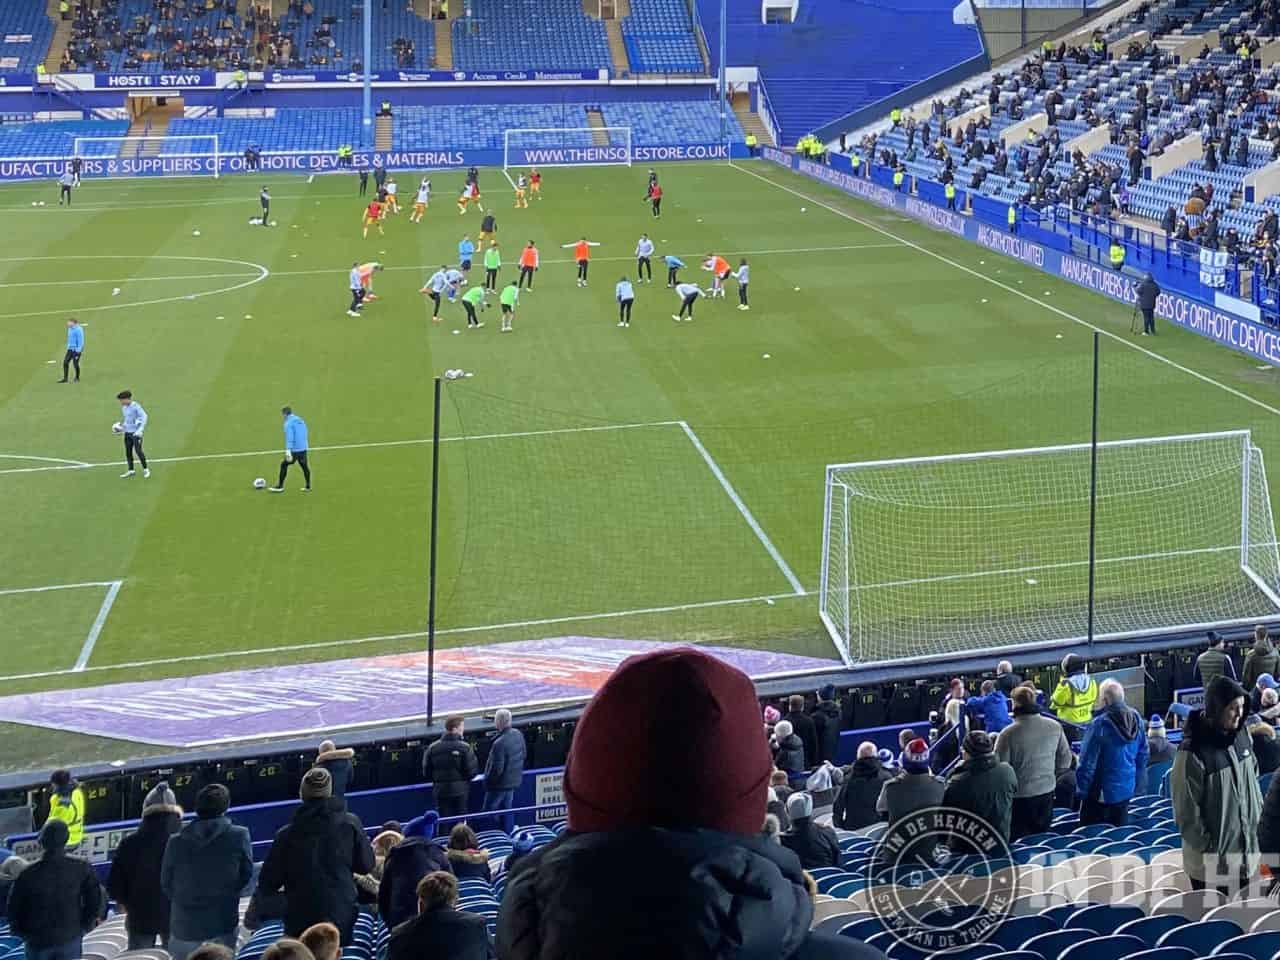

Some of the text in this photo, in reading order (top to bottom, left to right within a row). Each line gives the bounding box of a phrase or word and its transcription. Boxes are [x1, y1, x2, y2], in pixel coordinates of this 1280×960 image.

[107, 160, 119, 173] &
[122, 158, 201, 173] SUPPLIERS
[373, 153, 384, 168] &
[386, 151, 464, 167] MATERIALS
[525, 145, 729, 163] WWW.THEINSOLESTORE.CO.UK
[1060, 255, 1123, 298] MANUFACTURERS
[1175, 298, 1189, 322] OF
[1190, 304, 1238, 344] ORTHOTIC
